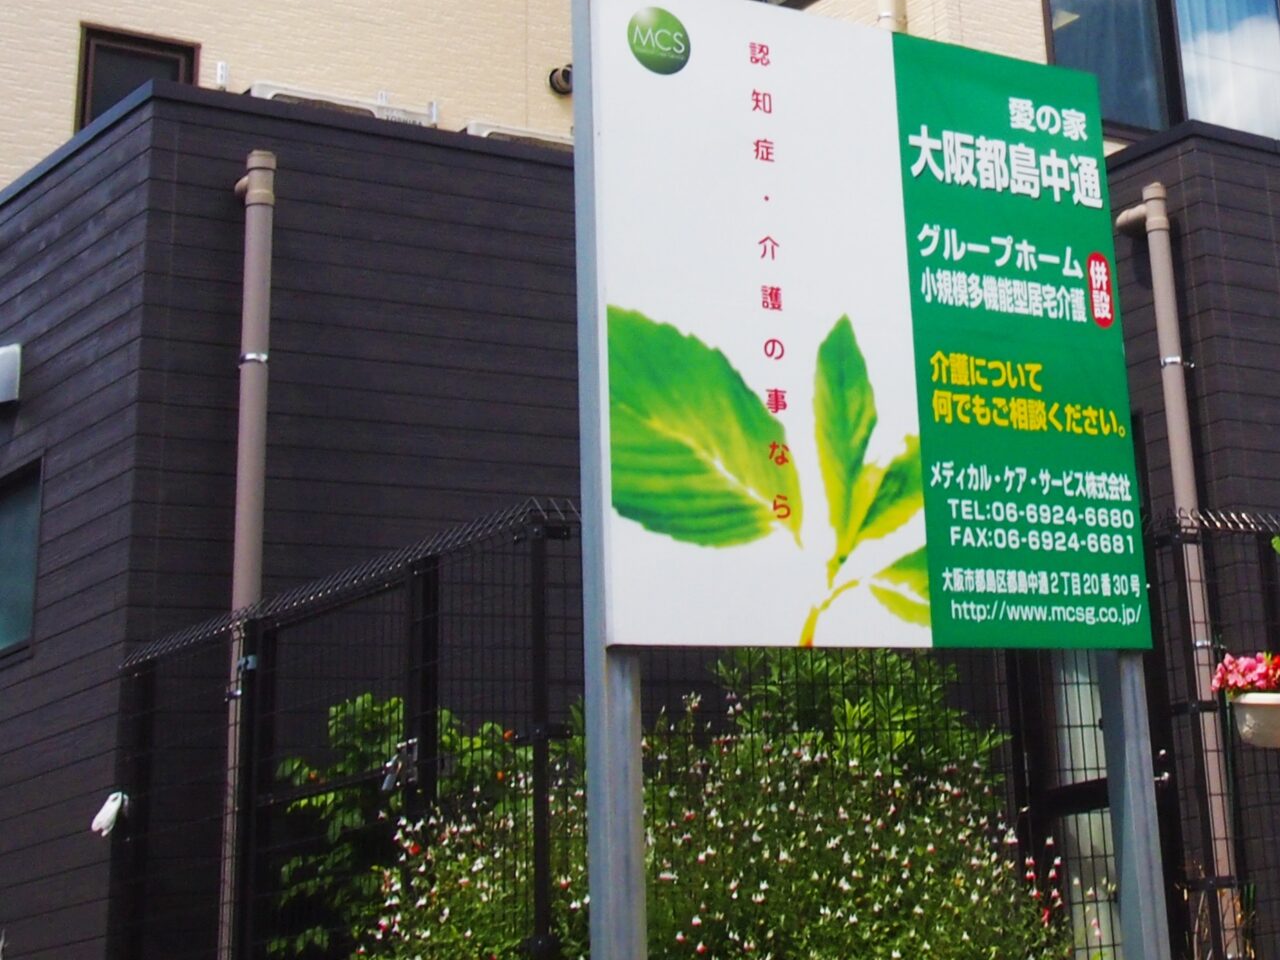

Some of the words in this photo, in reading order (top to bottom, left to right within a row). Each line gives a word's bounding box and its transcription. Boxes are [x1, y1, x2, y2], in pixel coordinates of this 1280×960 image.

[632, 23, 686, 54] MCS
[1008, 96, 1088, 141] 愛の家
[908, 124, 1104, 209] 大阪都島中通
[917, 223, 1084, 279] グループホーム
[749, 42, 791, 520] 認知症・介護の事なら
[920, 266, 1088, 323] 小規模多機能型居宅介護
[1089, 260, 1112, 320] 併設
[929, 351, 1043, 392] 介護について
[932, 389, 1126, 438] 何でもご相談ください。
[930, 461, 1132, 501] メディカル・ケア・サービス株式会社
[947, 498, 1135, 529] TEL:06-6924-6680
[949, 526, 1135, 555] FAX:06-6924-6681
[950, 599, 1142, 626] http://www.mcsg.co.jp/
